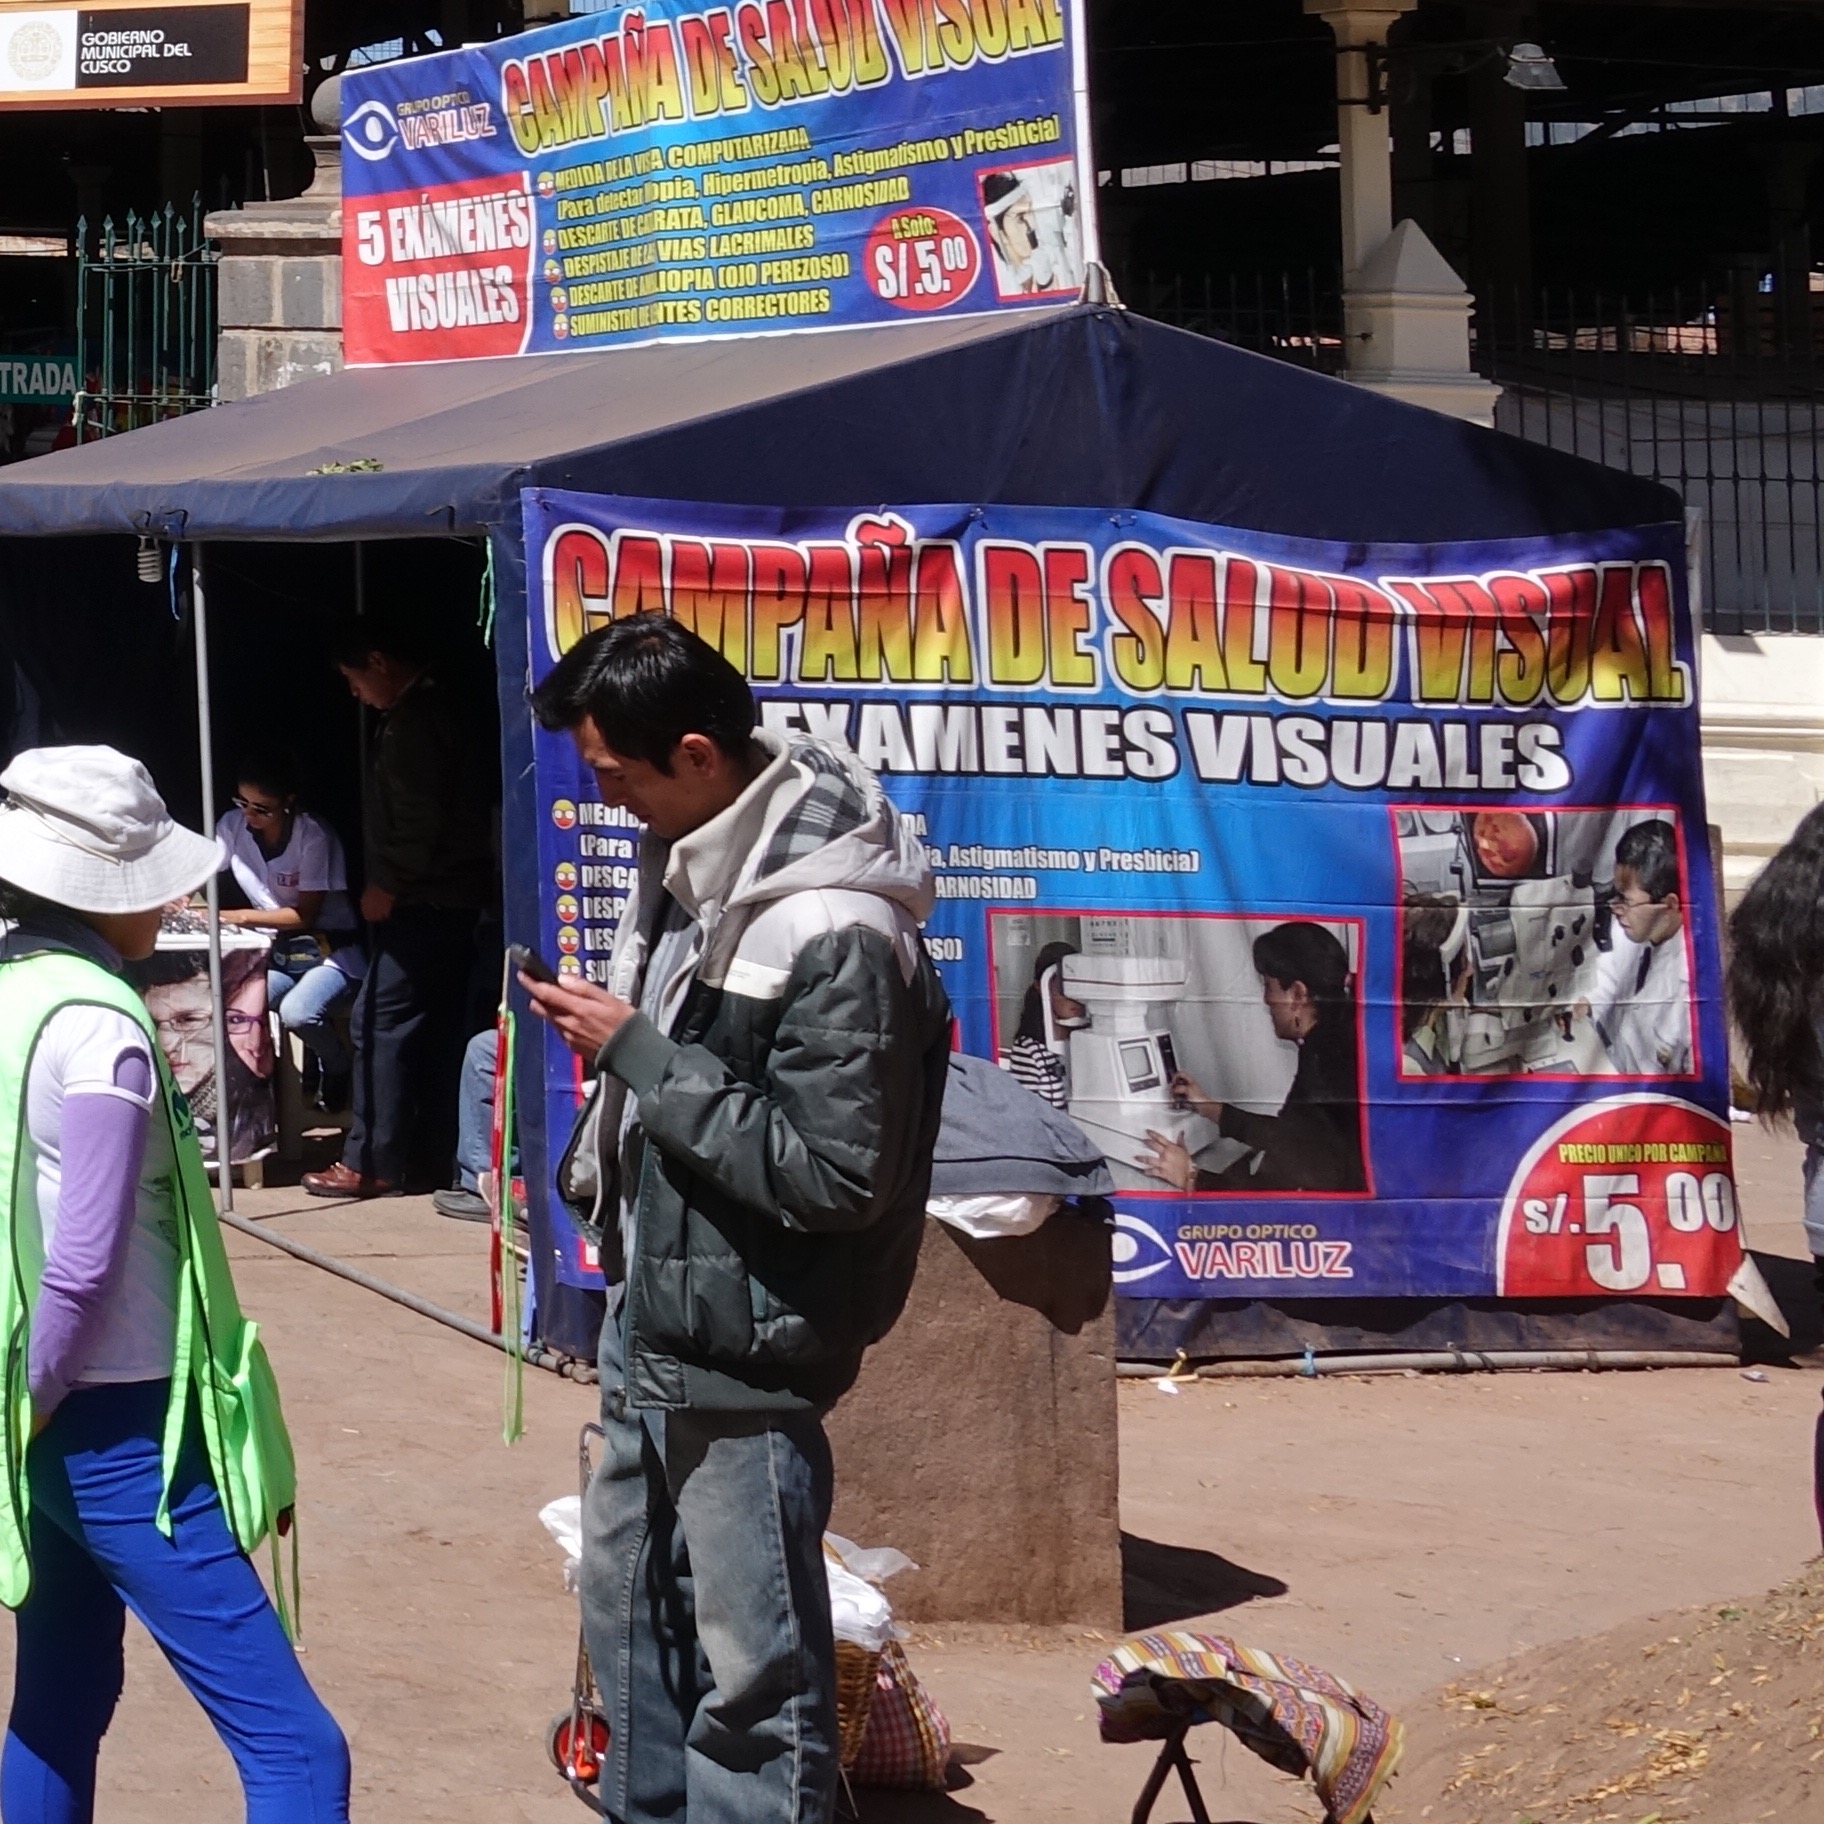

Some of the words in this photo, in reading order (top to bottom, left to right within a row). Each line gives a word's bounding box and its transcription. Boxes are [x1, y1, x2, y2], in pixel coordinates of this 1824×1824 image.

[80, 43, 161, 60] MUNICIPAL
[163, 42, 193, 57] DEL
[81, 29, 165, 46] GOBIERNO
[80, 59, 132, 74] CUSCO
[503, 8, 684, 154] CAMPAÑA
[680, 10, 752, 118] DE
[398, 102, 497, 151] VARILUZ
[668, 126, 812, 169] COMPUTARIZADA
[702, 158, 832, 197] Hipermetropia,
[834, 139, 949, 177] Astigmatismo
[950, 135, 964, 160] y
[711, 193, 810, 226] GLAUCOMA,
[812, 175, 910, 214] CARNOSIDAD
[358, 211, 386, 266] 5
[388, 187, 530, 261] EXÁMENES
[656, 237, 707, 262] VIAS
[709, 223, 815, 258] LACRIMALES
[901, 215, 938, 238] Solo:
[718, 263, 757, 289] (OJO
[760, 252, 850, 285] PEREZOSO)
[385, 266, 520, 334] VISUALES
[705, 287, 831, 322] CORRECTORES
[982, 546, 1096, 687] DE
[1109, 547, 1395, 699] SALUD
[1384, 567, 1688, 705] VISUAL
[1185, 712, 1570, 791] VISUALES
[578, 803, 648, 829] MEDID
[948, 845, 1080, 871] Astigmatismo
[1083, 852, 1097, 873] y
[1098, 848, 1200, 873] Presbicia)
[581, 865, 639, 890] DESCA
[934, 875, 1038, 899] ARNOSIDAD
[1558, 1143, 1607, 1164] PRECIO
[1644, 1143, 1668, 1163] POR
[1178, 1224, 1244, 1240] GRUPO
[1248, 1223, 1318, 1240] OPTICO
[1177, 1241, 1353, 1279] VARILUZ
